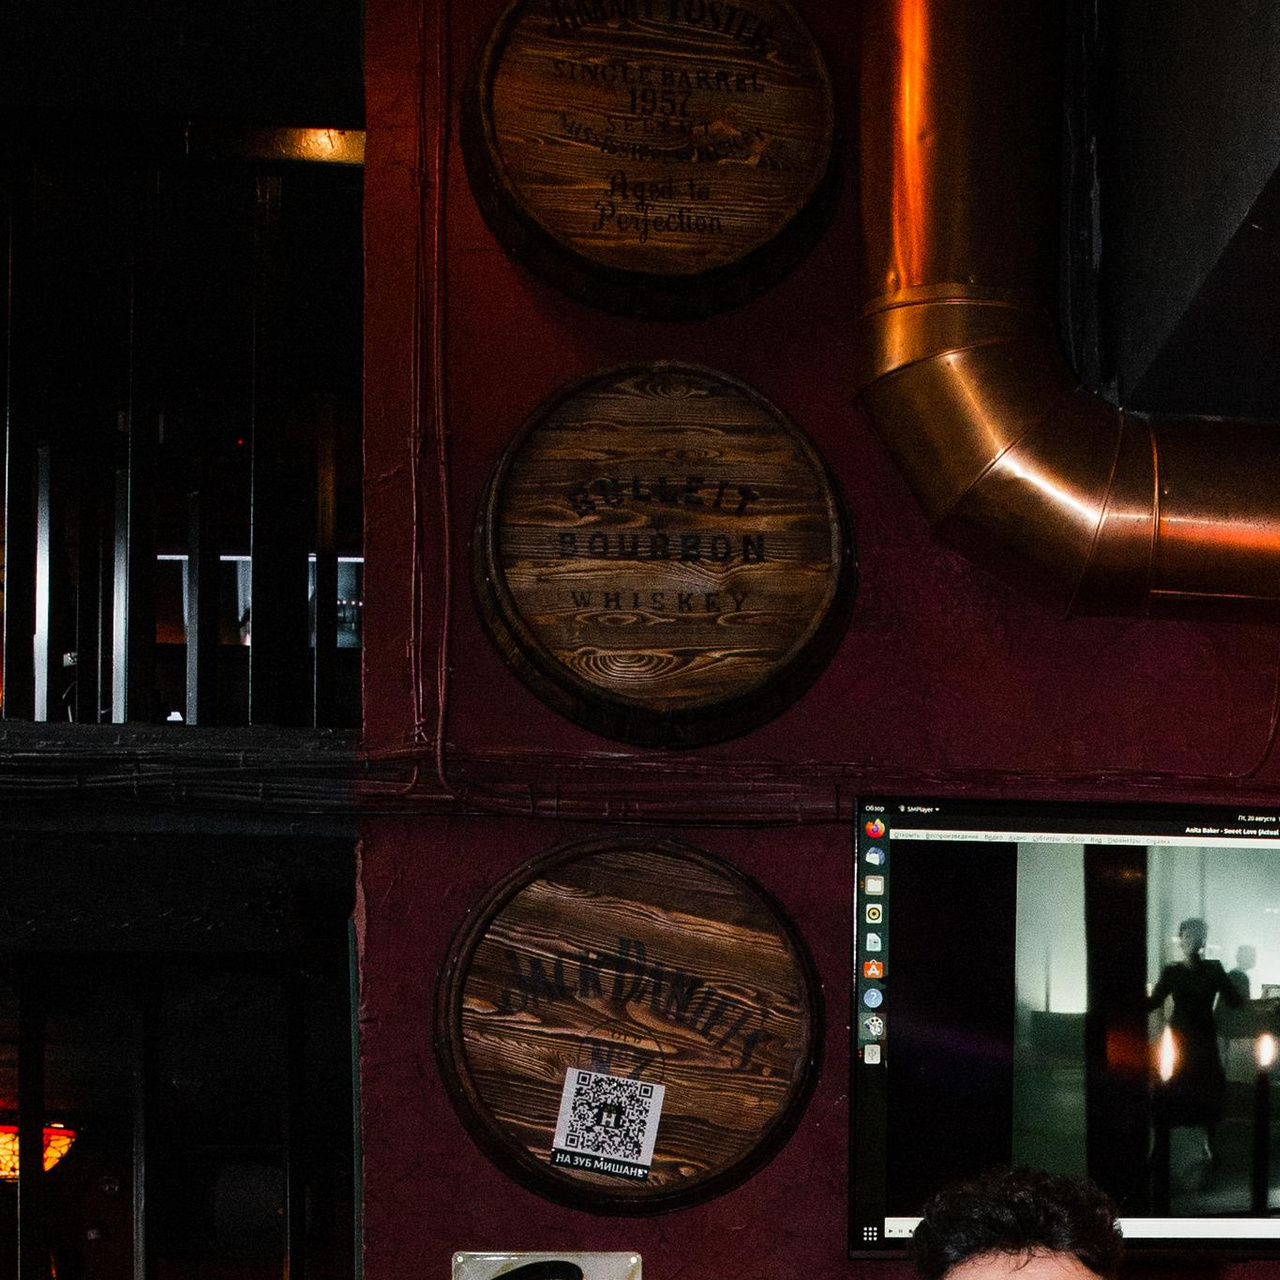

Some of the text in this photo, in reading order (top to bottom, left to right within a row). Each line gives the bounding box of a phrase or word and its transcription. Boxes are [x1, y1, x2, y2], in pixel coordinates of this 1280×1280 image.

[552, 61, 765, 93] SINGLE BARREL
[608, 169, 675, 210] Aged
[592, 201, 724, 244] Perfection
[558, 532, 766, 564] BOURBON
[571, 591, 750, 614] WHISKEY
[865, 805, 885, 813] Обзор
[907, 806, 934, 814] SMPlayer
[556, 1153, 645, 1178] НА ЗУБ МИШАНЕ
